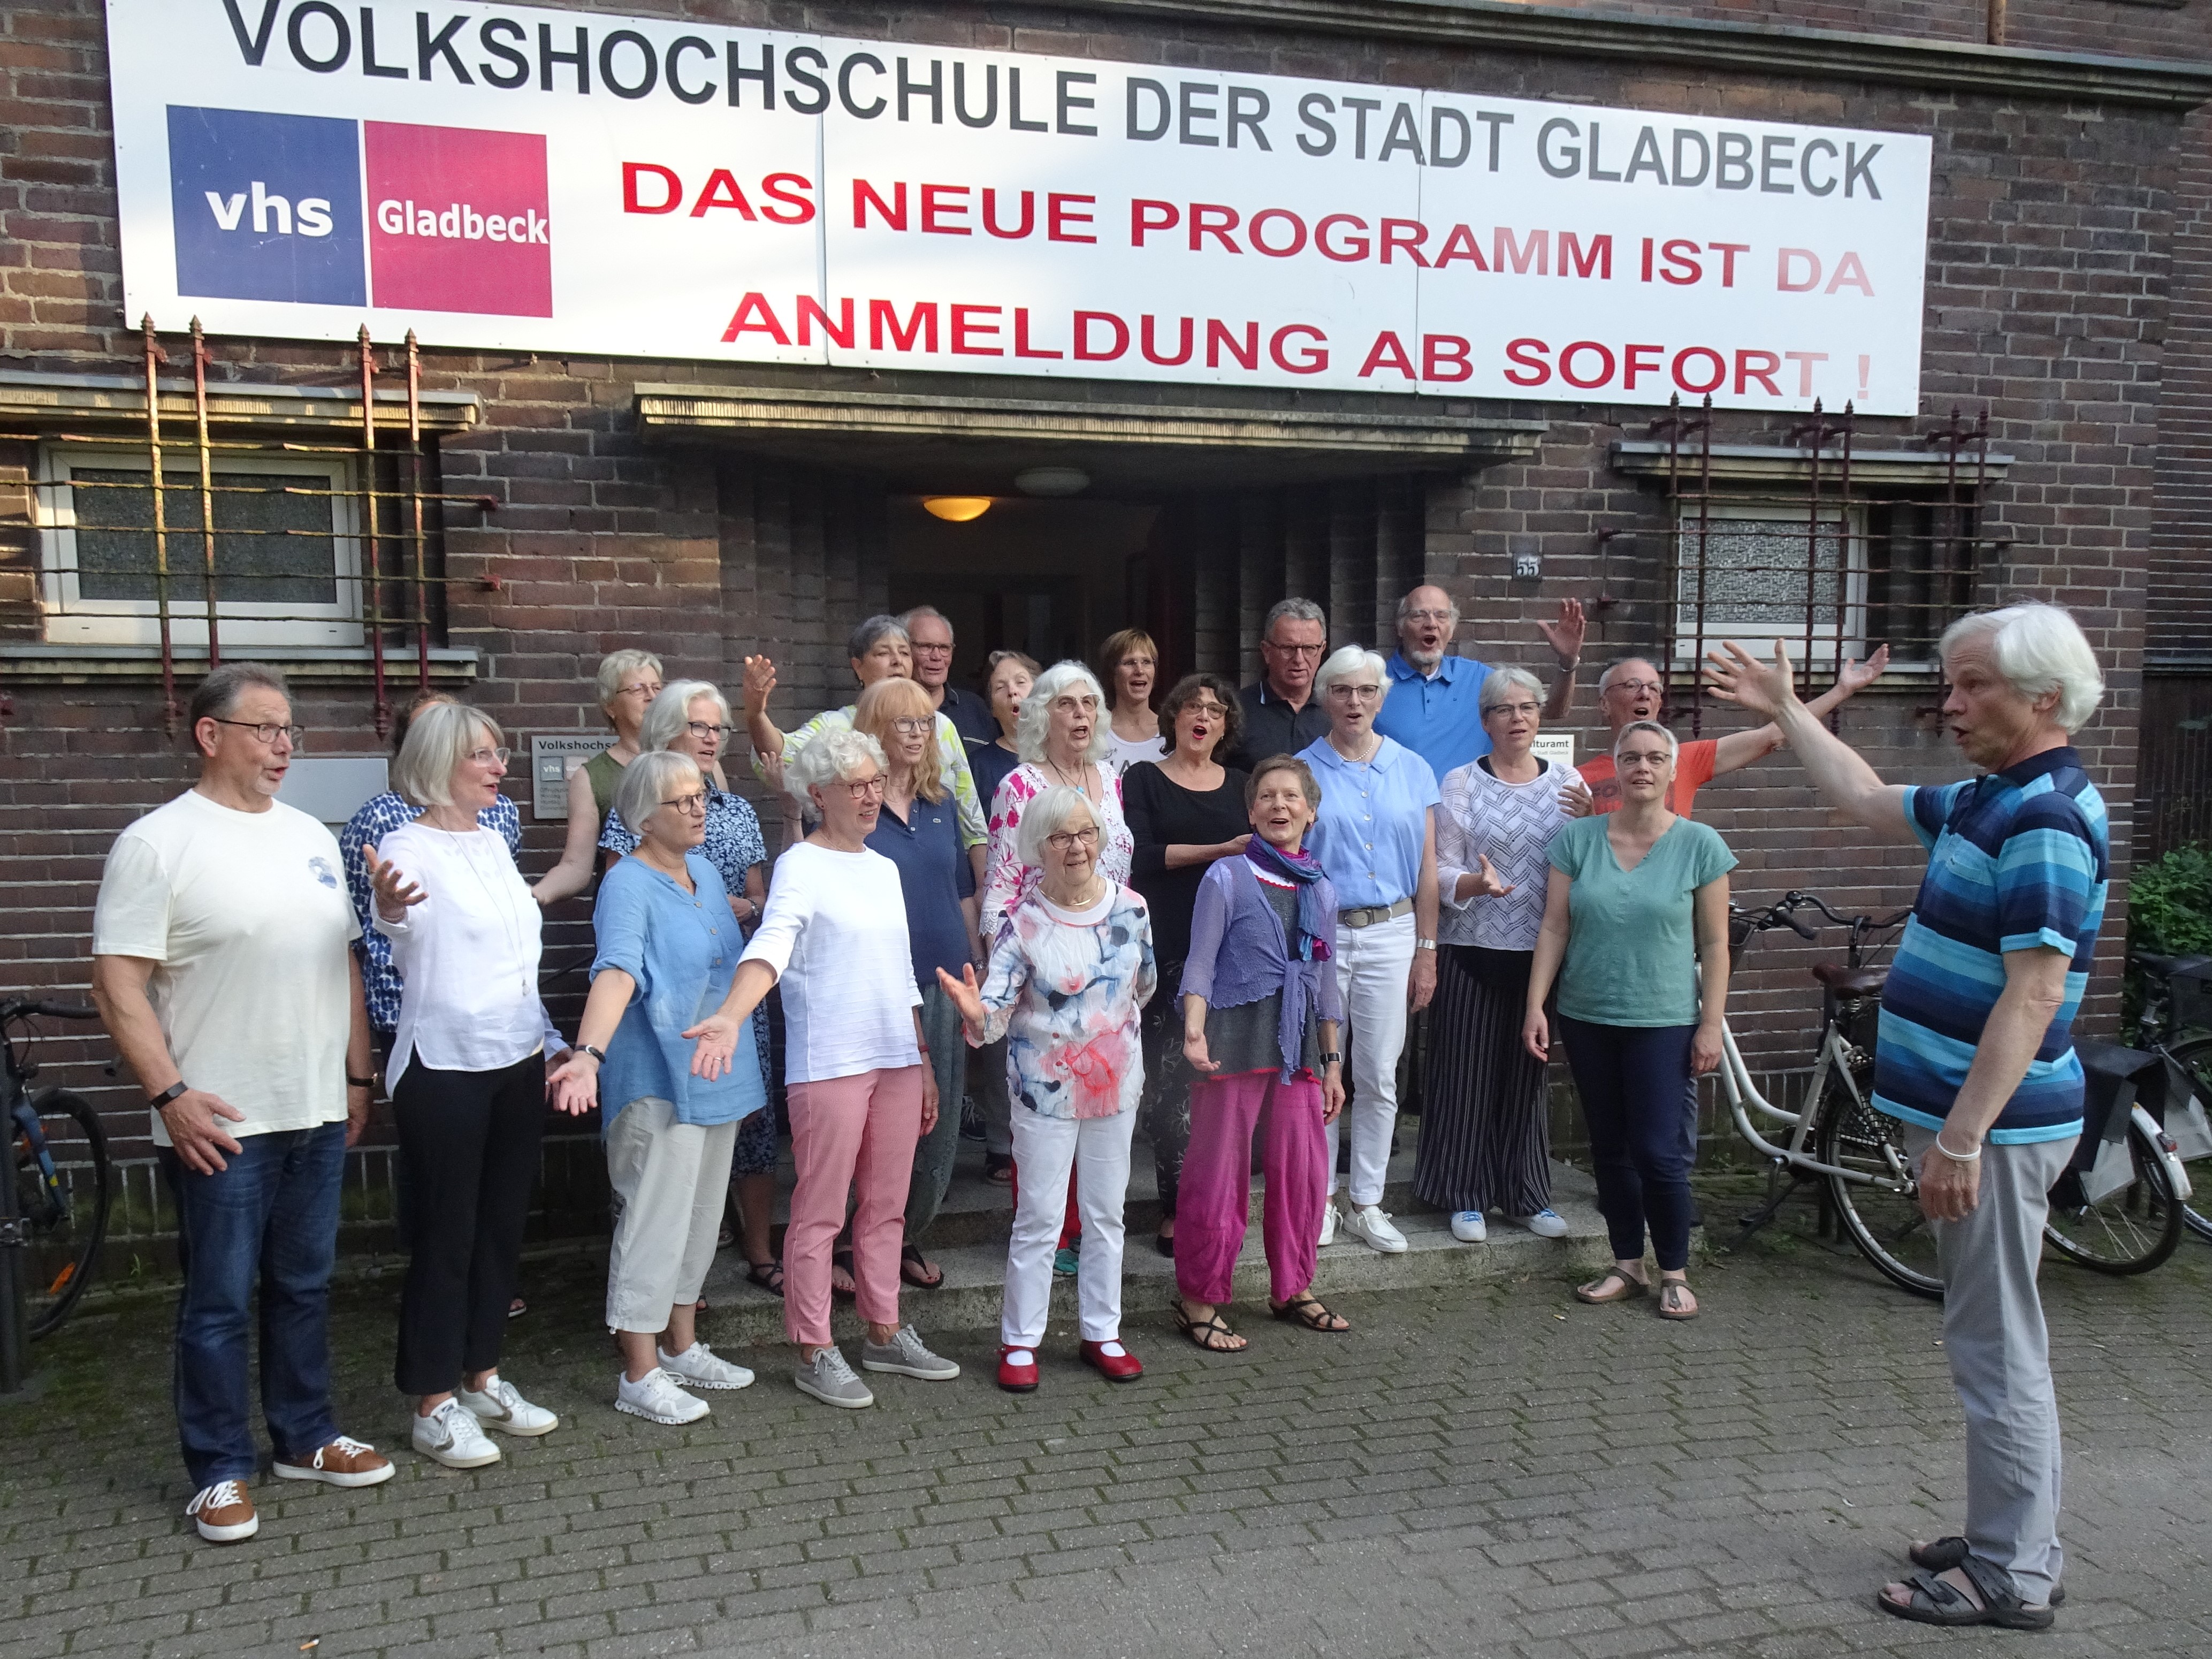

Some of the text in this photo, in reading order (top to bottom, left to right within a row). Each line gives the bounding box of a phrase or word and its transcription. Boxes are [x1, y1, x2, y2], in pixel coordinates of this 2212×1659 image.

[222, 0, 1883, 200] VOLKSHOCHSCHULE DER STADT GLADBECK
[204, 181, 333, 237] vhs
[377, 199, 550, 245] Gladbeck
[622, 161, 1875, 296] DAS NEUE PROGRAMM IST DA
[720, 292, 1870, 400] ANMELDUNG AB SOFORT !
[1516, 557, 1539, 576] 55
[543, 765, 561, 773] vhs
